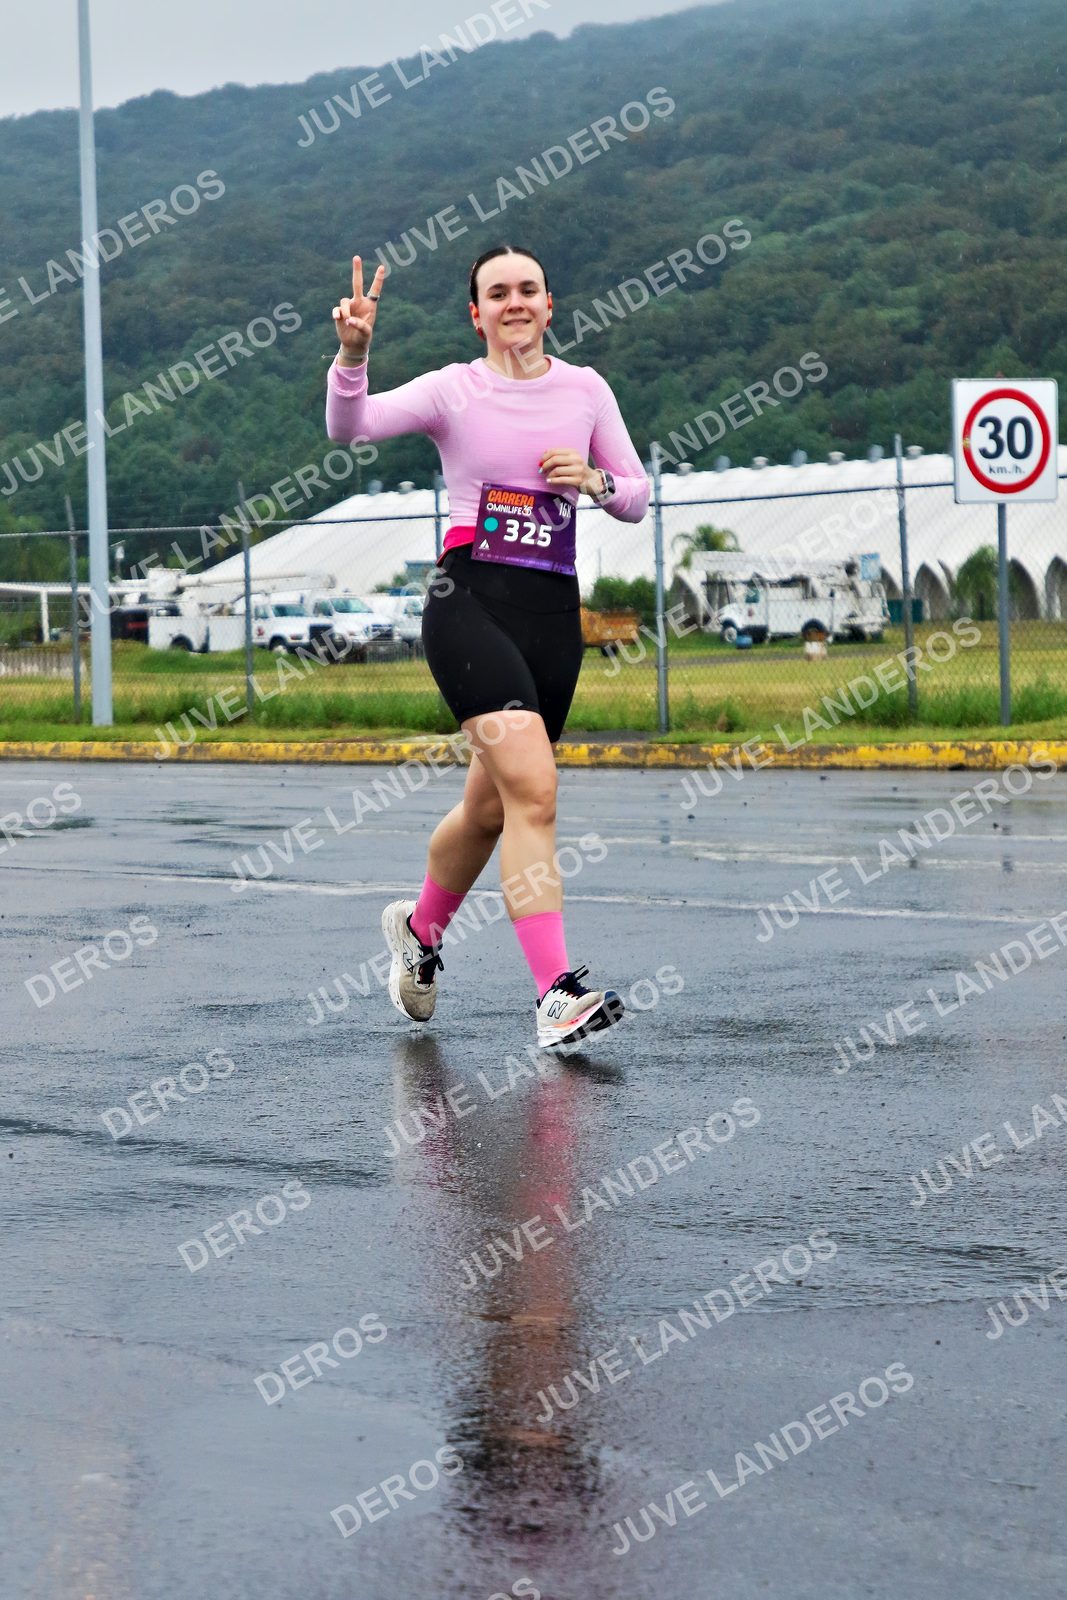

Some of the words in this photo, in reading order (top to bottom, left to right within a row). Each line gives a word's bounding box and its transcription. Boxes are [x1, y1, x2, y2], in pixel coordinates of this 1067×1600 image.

[978, 416, 1033, 460] 30
[488, 489, 535, 506] CARRERA
[503, 519, 552, 547] 325
